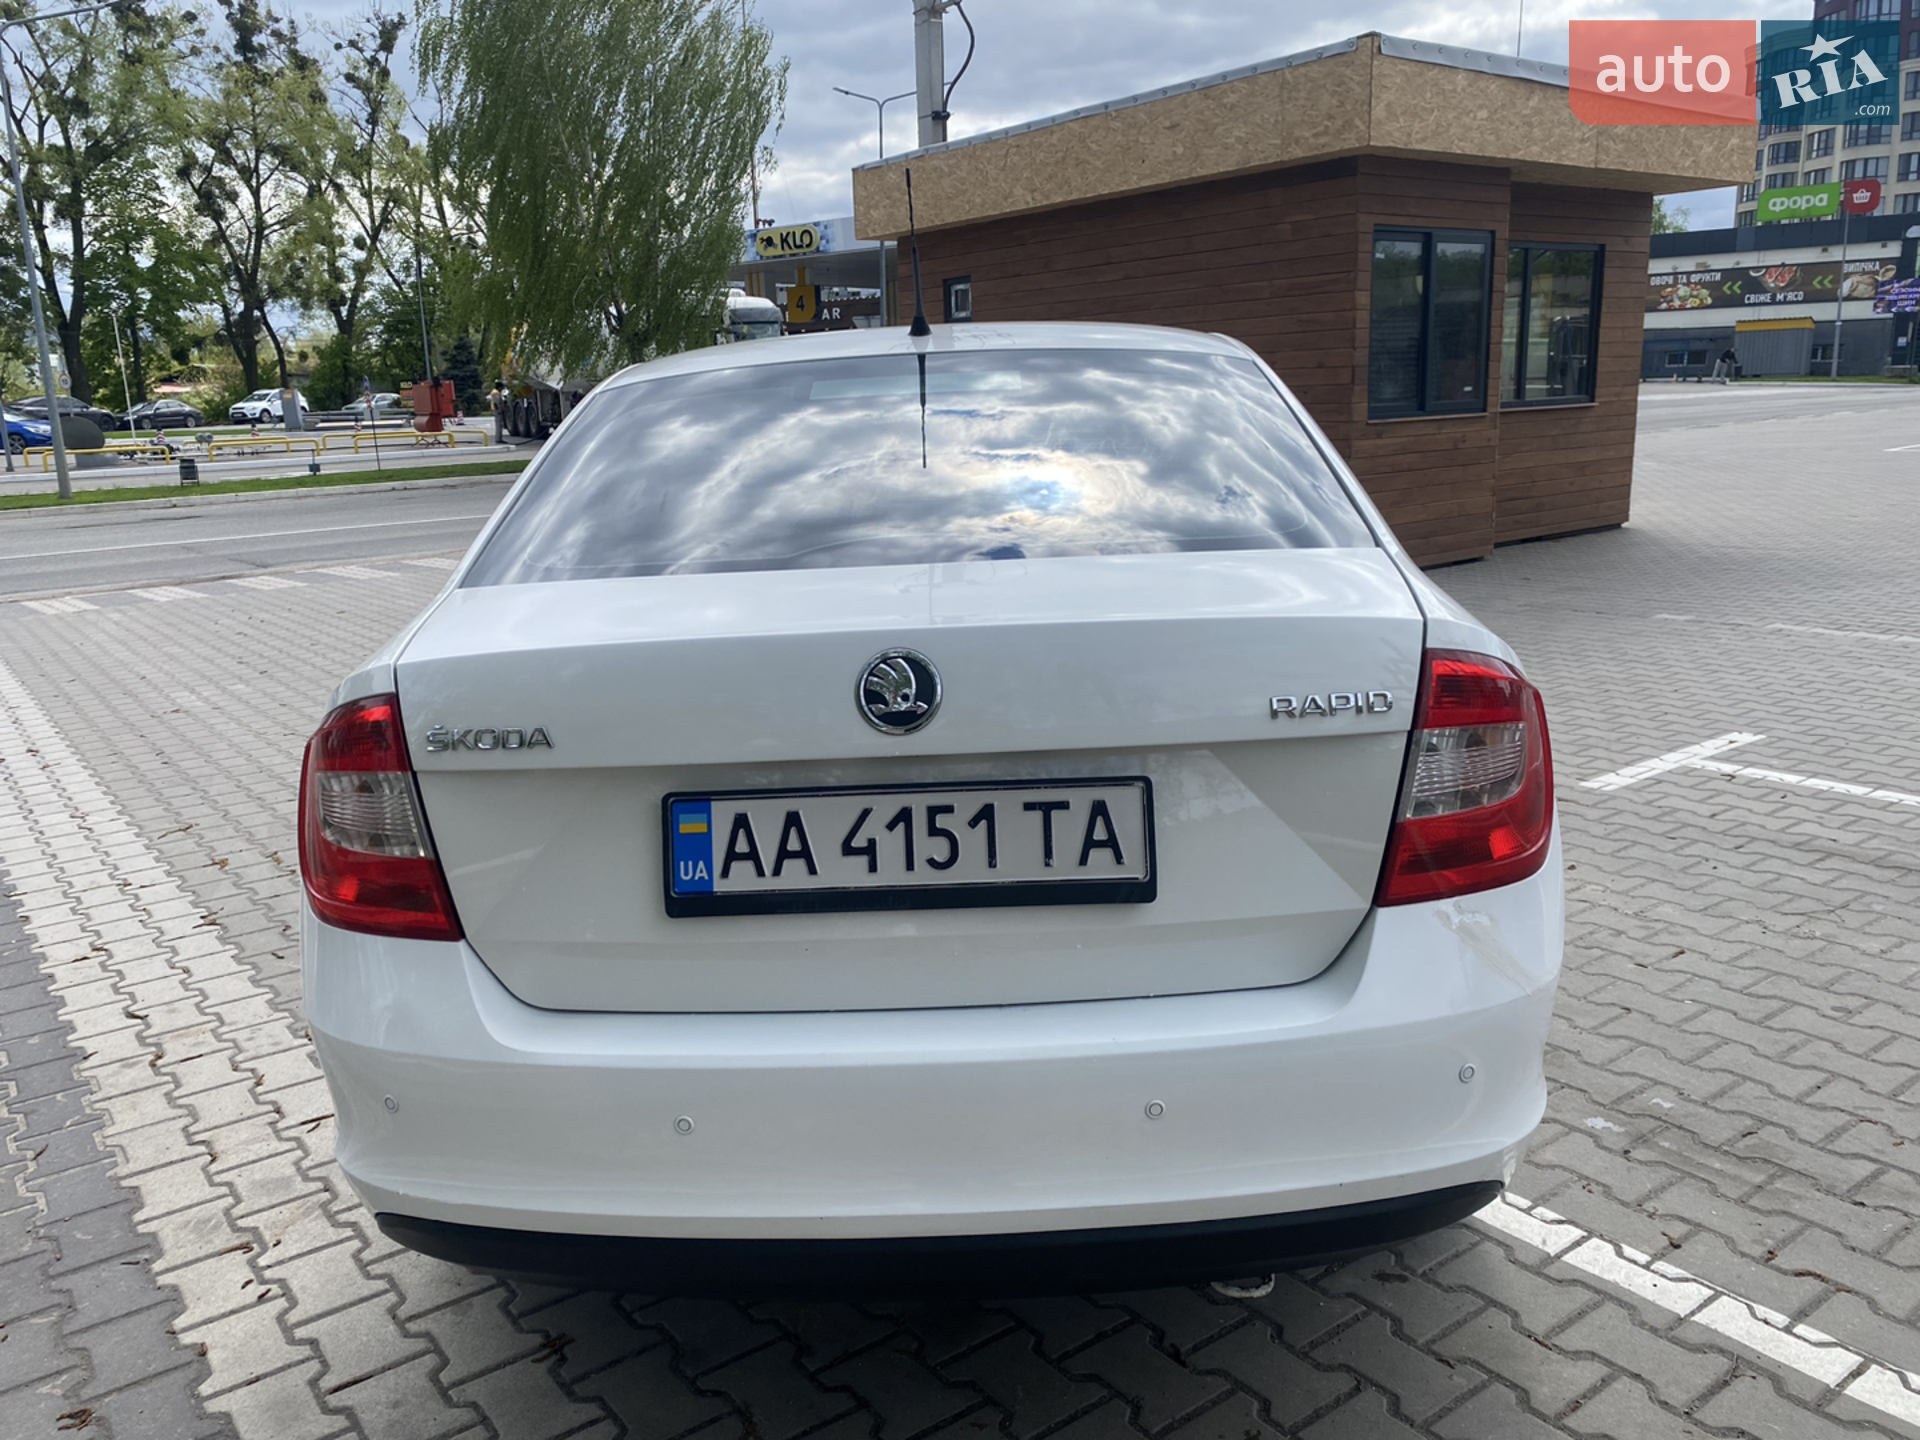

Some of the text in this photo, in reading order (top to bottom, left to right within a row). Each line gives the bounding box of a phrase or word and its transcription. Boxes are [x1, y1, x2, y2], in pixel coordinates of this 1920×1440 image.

[780, 229, 814, 251] KLO
[1677, 275, 1688, 283] ТА
[796, 295, 806, 312] 4
[1269, 690, 1393, 719] RAPID
[426, 724, 555, 752] ŠKODA
[720, 799, 1125, 878] AA 4151 TA
[680, 860, 709, 880] UA
